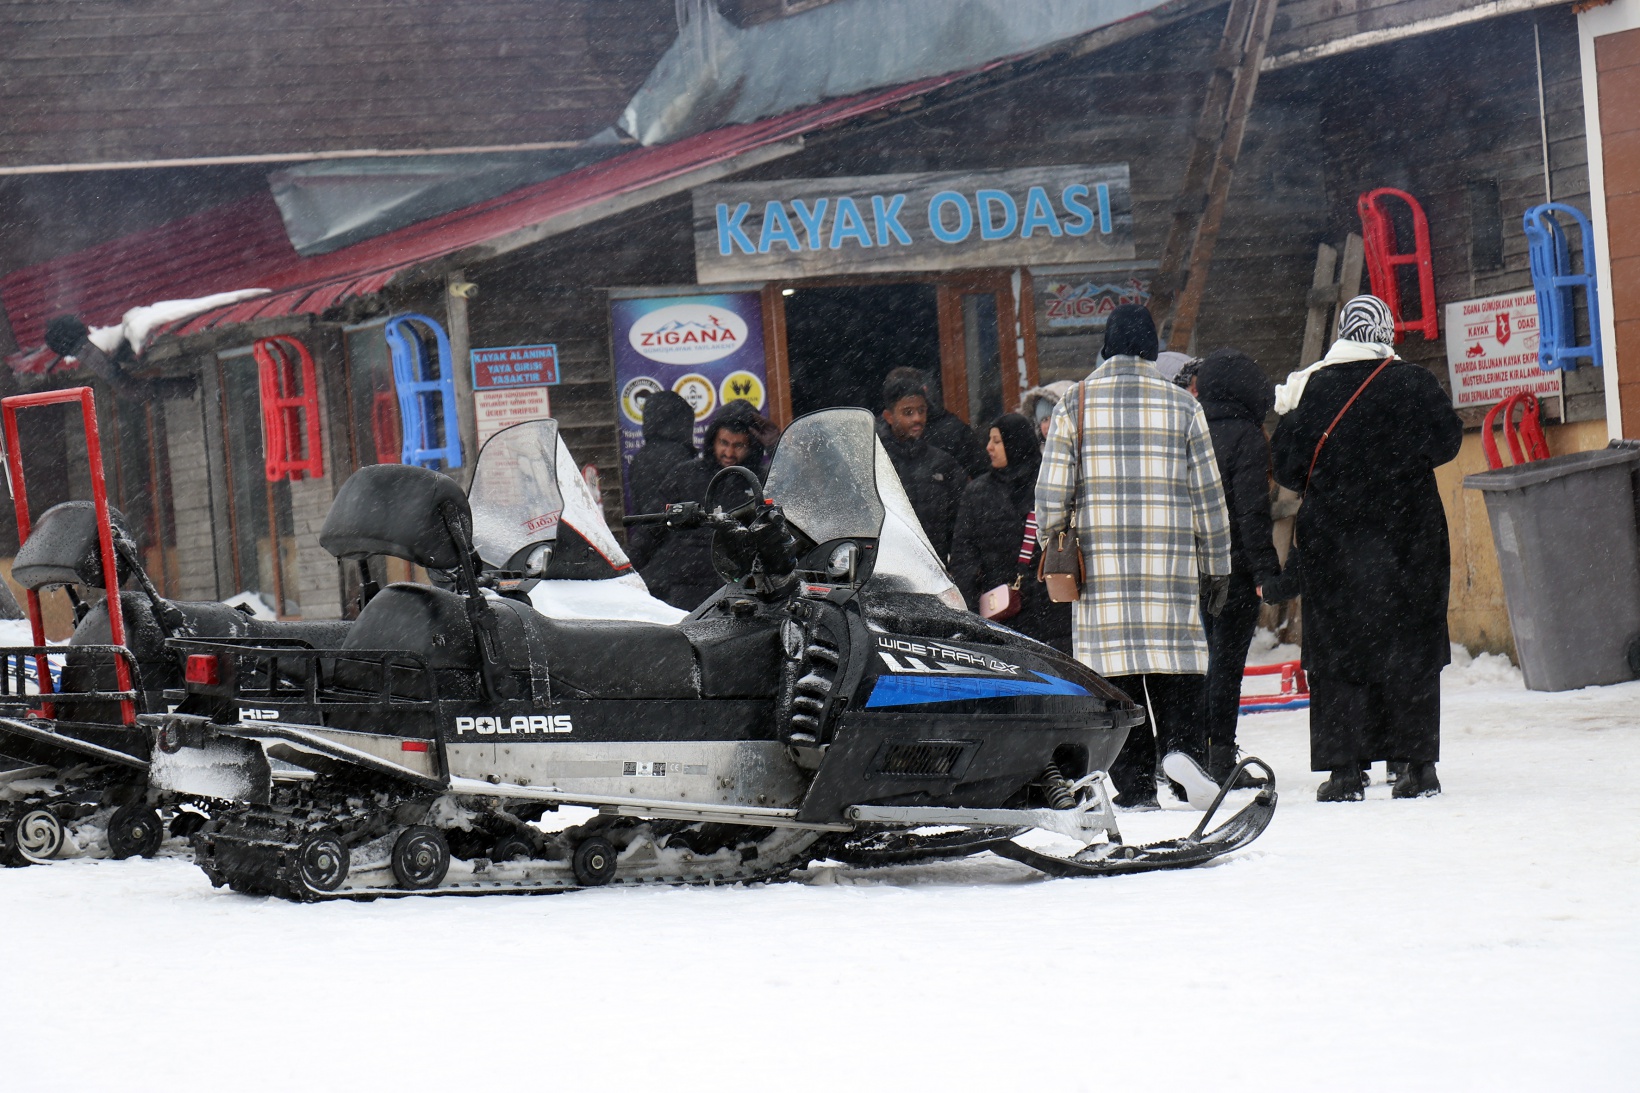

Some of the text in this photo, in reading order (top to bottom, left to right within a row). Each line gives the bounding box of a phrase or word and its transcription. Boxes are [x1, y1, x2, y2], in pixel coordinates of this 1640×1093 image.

[715, 183, 1112, 256] KAYAK ODASI
[1468, 318, 1536, 337] KAYAK ODASI
[474, 349, 552, 363] KAYAK ALANINA
[1478, 357, 1502, 370] BULUNAN
[1503, 354, 1521, 367] KAYAK
[487, 364, 511, 374] YAYA
[491, 372, 541, 384] YASAKTIR
[878, 637, 1020, 675] WIDETRAK LX
[456, 715, 573, 735] POLARIS
